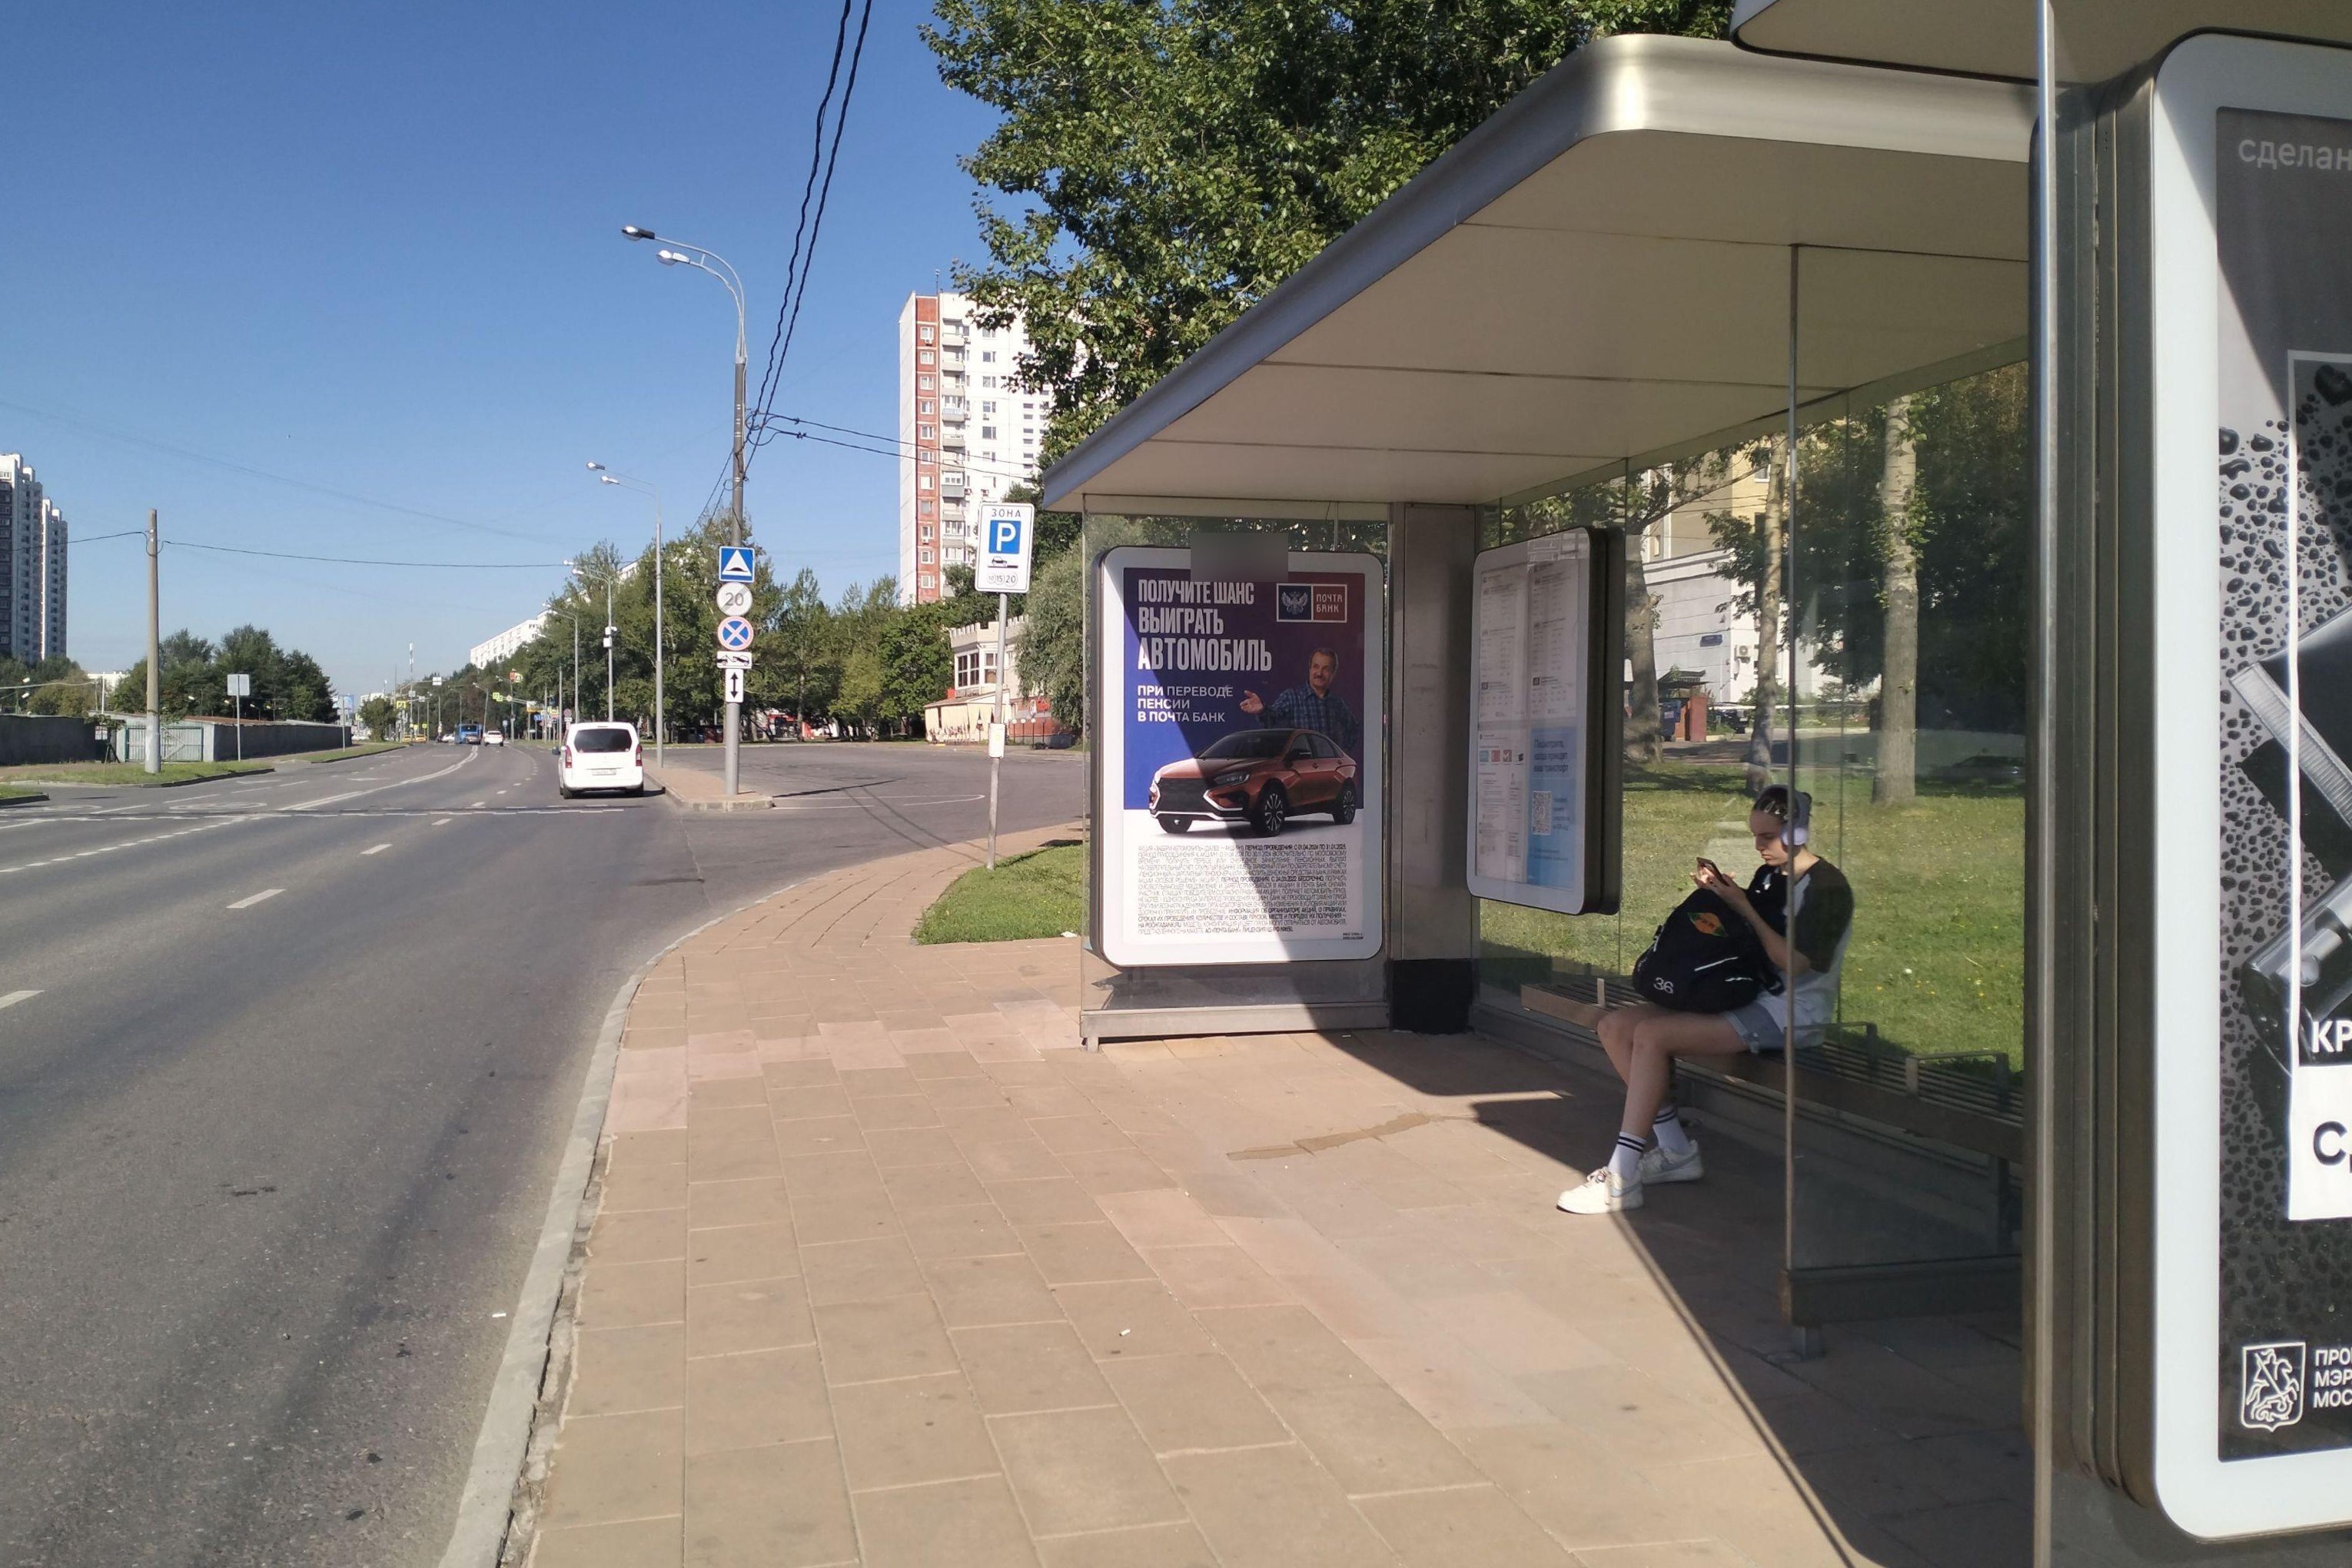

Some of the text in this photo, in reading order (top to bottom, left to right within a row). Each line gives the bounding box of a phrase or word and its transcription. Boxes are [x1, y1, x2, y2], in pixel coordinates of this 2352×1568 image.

[992, 508, 1022, 518] ЗОНА
[996, 522, 1016, 552] P
[1005, 574, 1016, 583] 20
[725, 592, 744, 606] 20
[1138, 580, 1254, 605] ПОЛУЧИТЕ ШАНС
[1316, 593, 1343, 603] ПОЧТА
[1316, 603, 1339, 613] БАНК
[1138, 606, 1224, 635] ВЫИГРАТЬ
[1138, 637, 1272, 672] АВТОМОБИЛЬ
[1138, 685, 1234, 699] ПРИ ПЕРЕВОДЕ
[1138, 698, 1191, 709] ПЕНСИИ
[1138, 711, 1226, 723] В ПОЧТА БАНК
[1654, 977, 1673, 994] 36
[2314, 1121, 2352, 1174] С
[2315, 1347, 2352, 1366] ПРО
